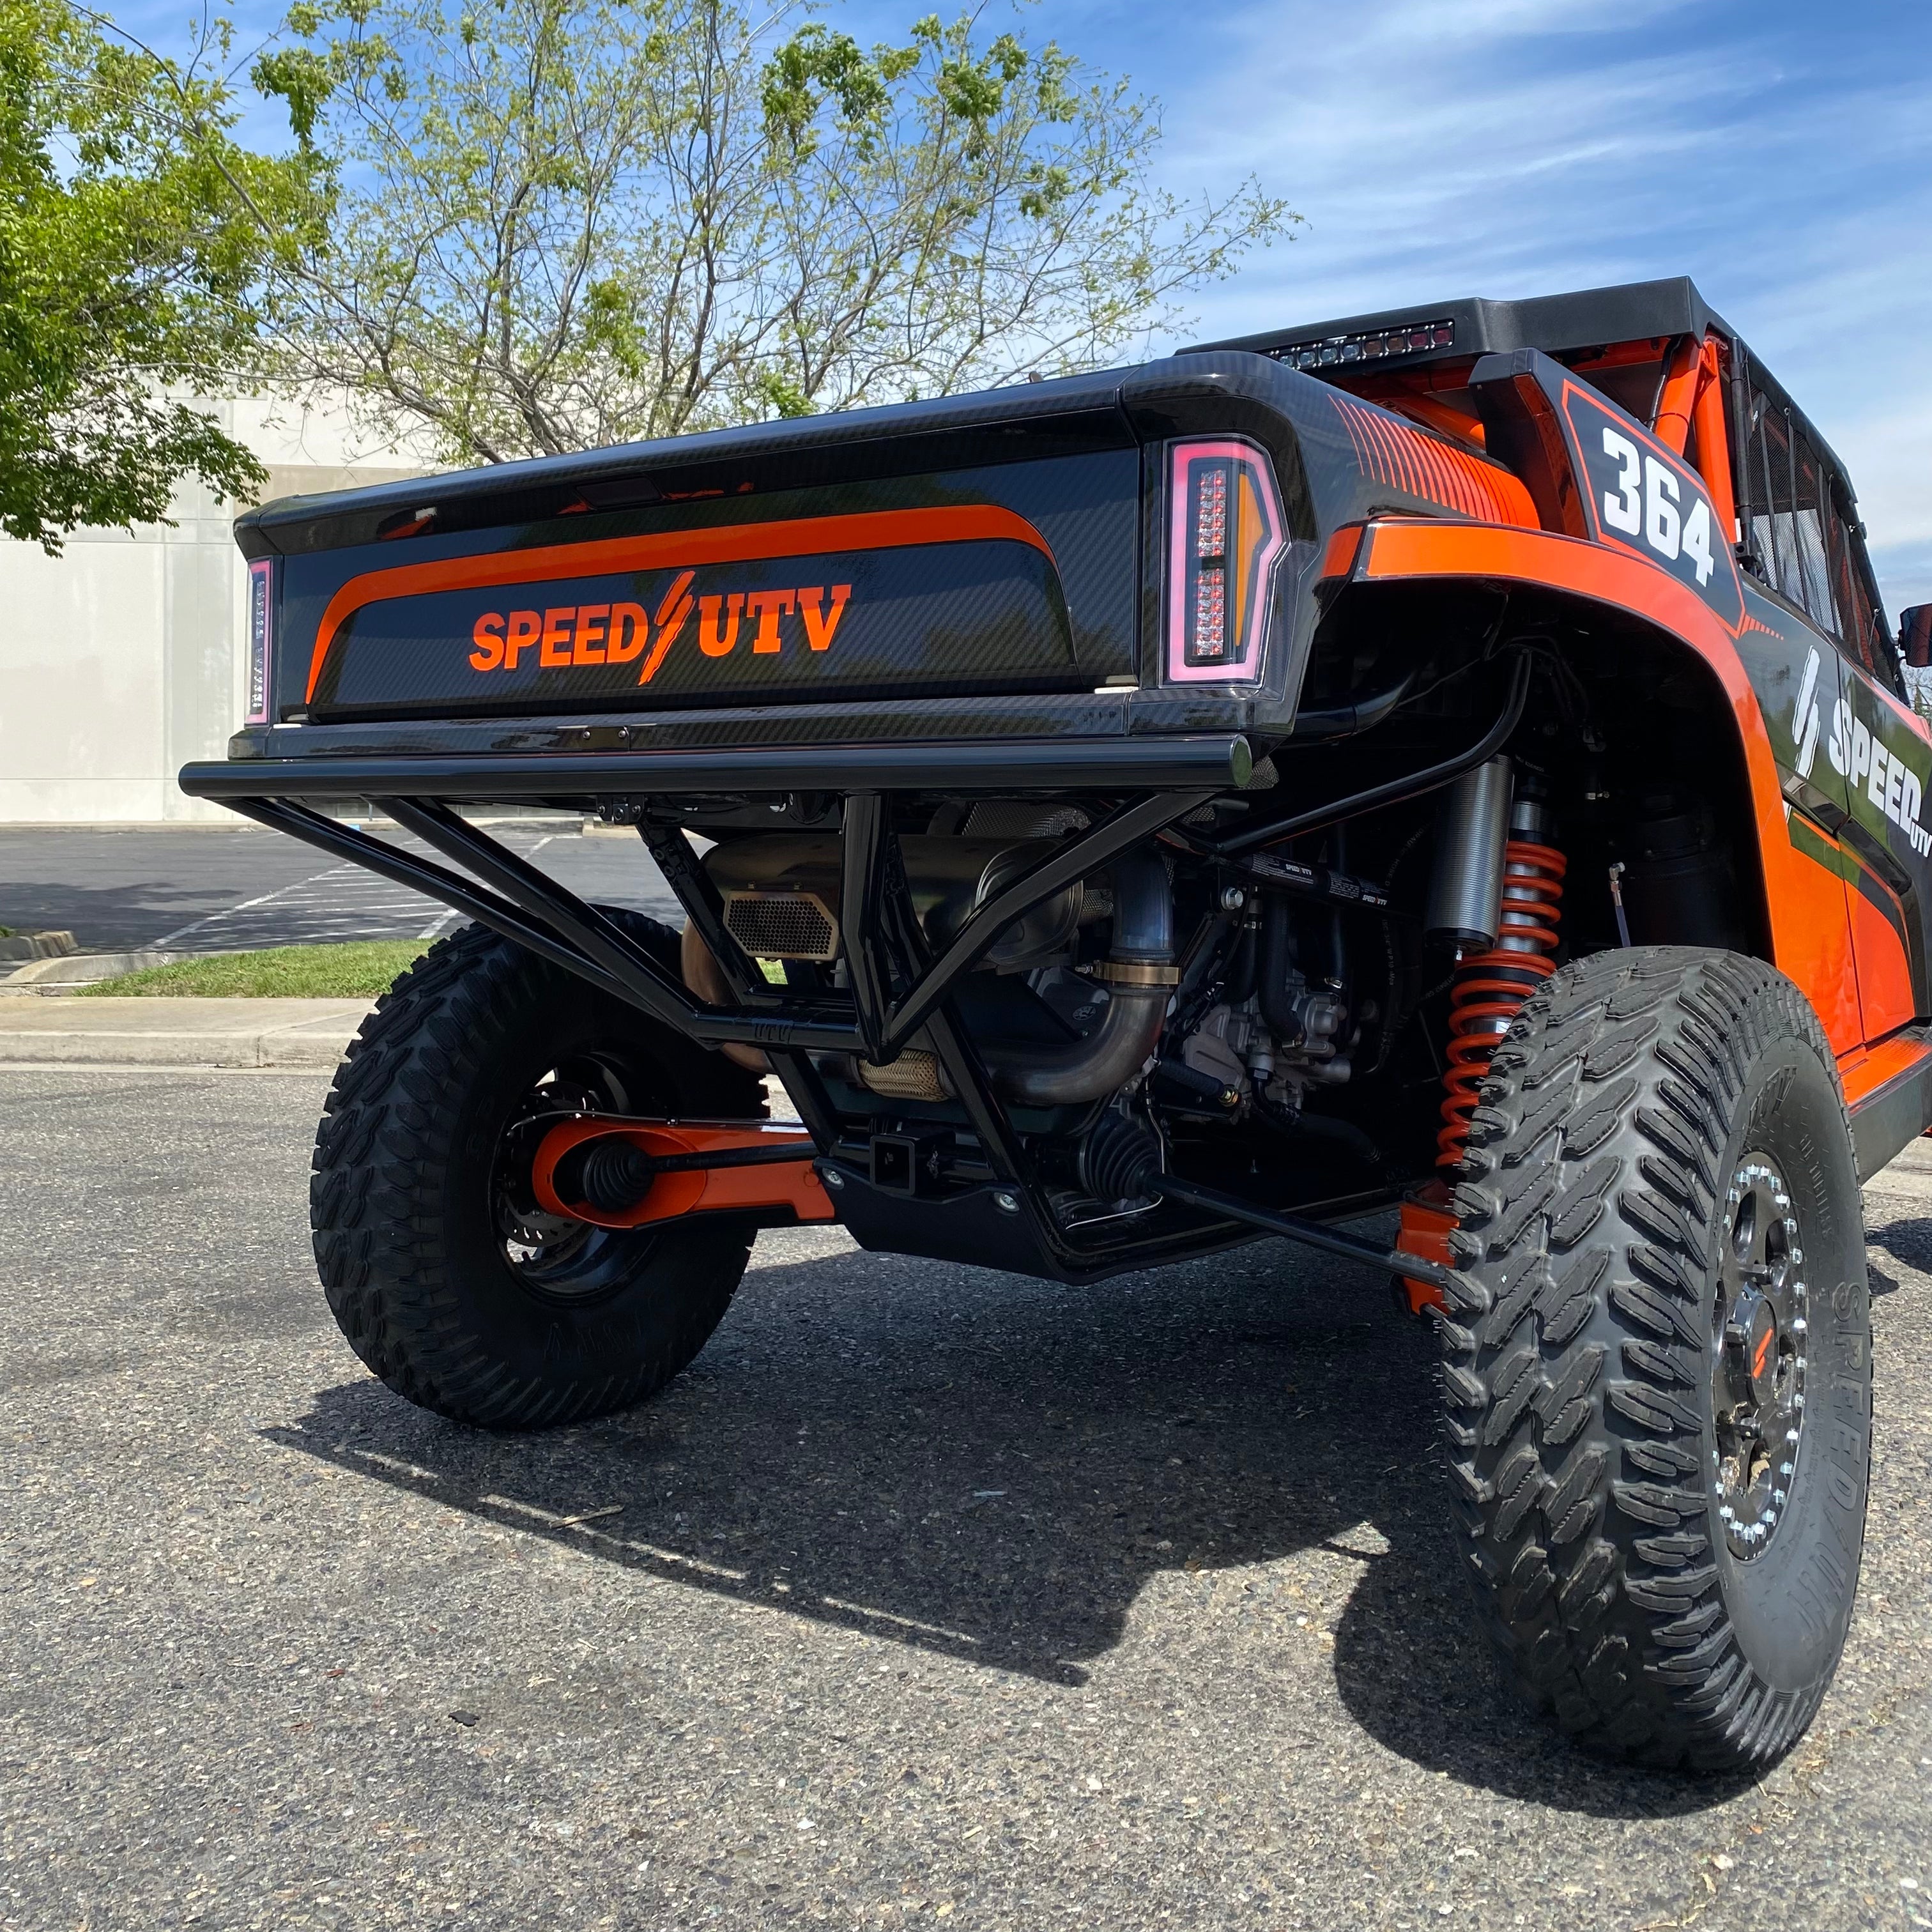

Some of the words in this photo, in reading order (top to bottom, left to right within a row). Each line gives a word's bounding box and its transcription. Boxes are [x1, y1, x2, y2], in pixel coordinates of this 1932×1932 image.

[1602, 426, 1713, 588] 364
[468, 601, 649, 671] SPEED
[698, 584, 852, 657] UTV
[1828, 698, 1922, 835] SPEED
[1910, 823, 1932, 858] UTV
[1825, 1280, 1865, 1514] SPEED
